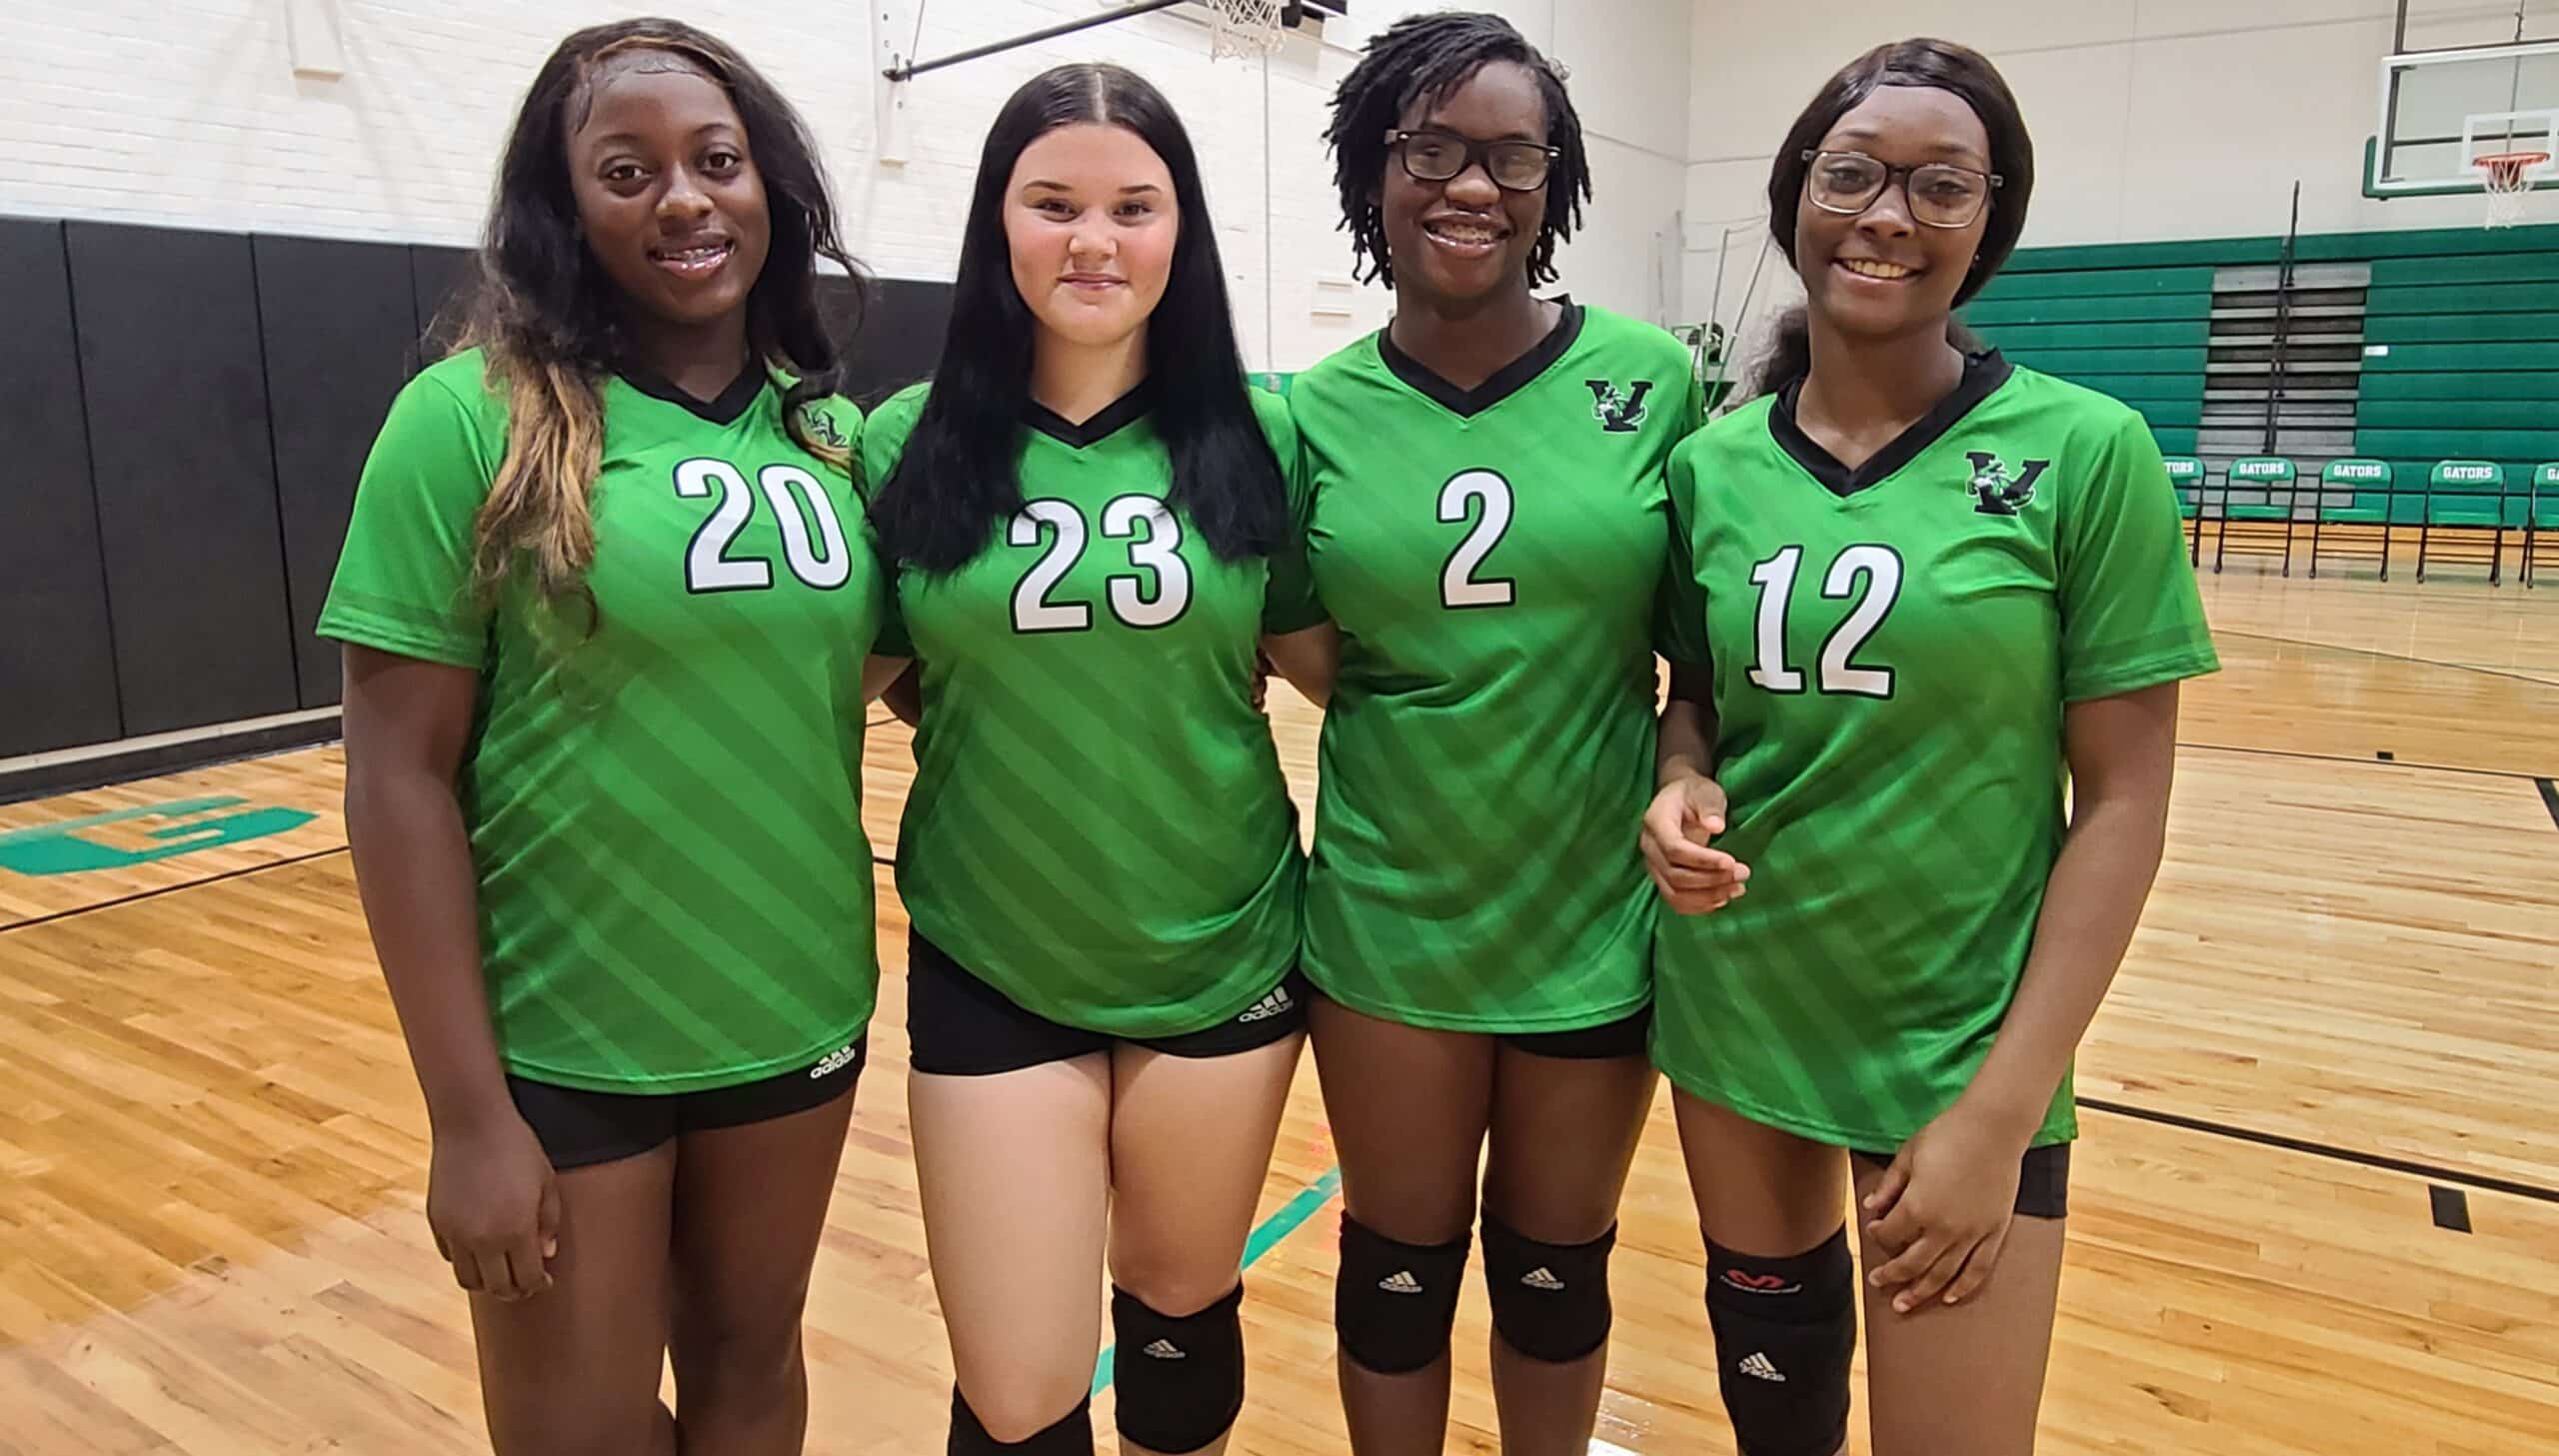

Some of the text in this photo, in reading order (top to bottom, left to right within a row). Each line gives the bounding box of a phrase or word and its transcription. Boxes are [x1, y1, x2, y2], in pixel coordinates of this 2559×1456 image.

[672, 457, 852, 595] 20
[2239, 463, 2285, 474] GATORS
[2333, 465, 2381, 477] GATORS
[2443, 467, 2492, 479] GATORS
[1007, 493, 1194, 635] 23
[1436, 467, 1515, 610] 2
[1744, 544, 1904, 699] 12
